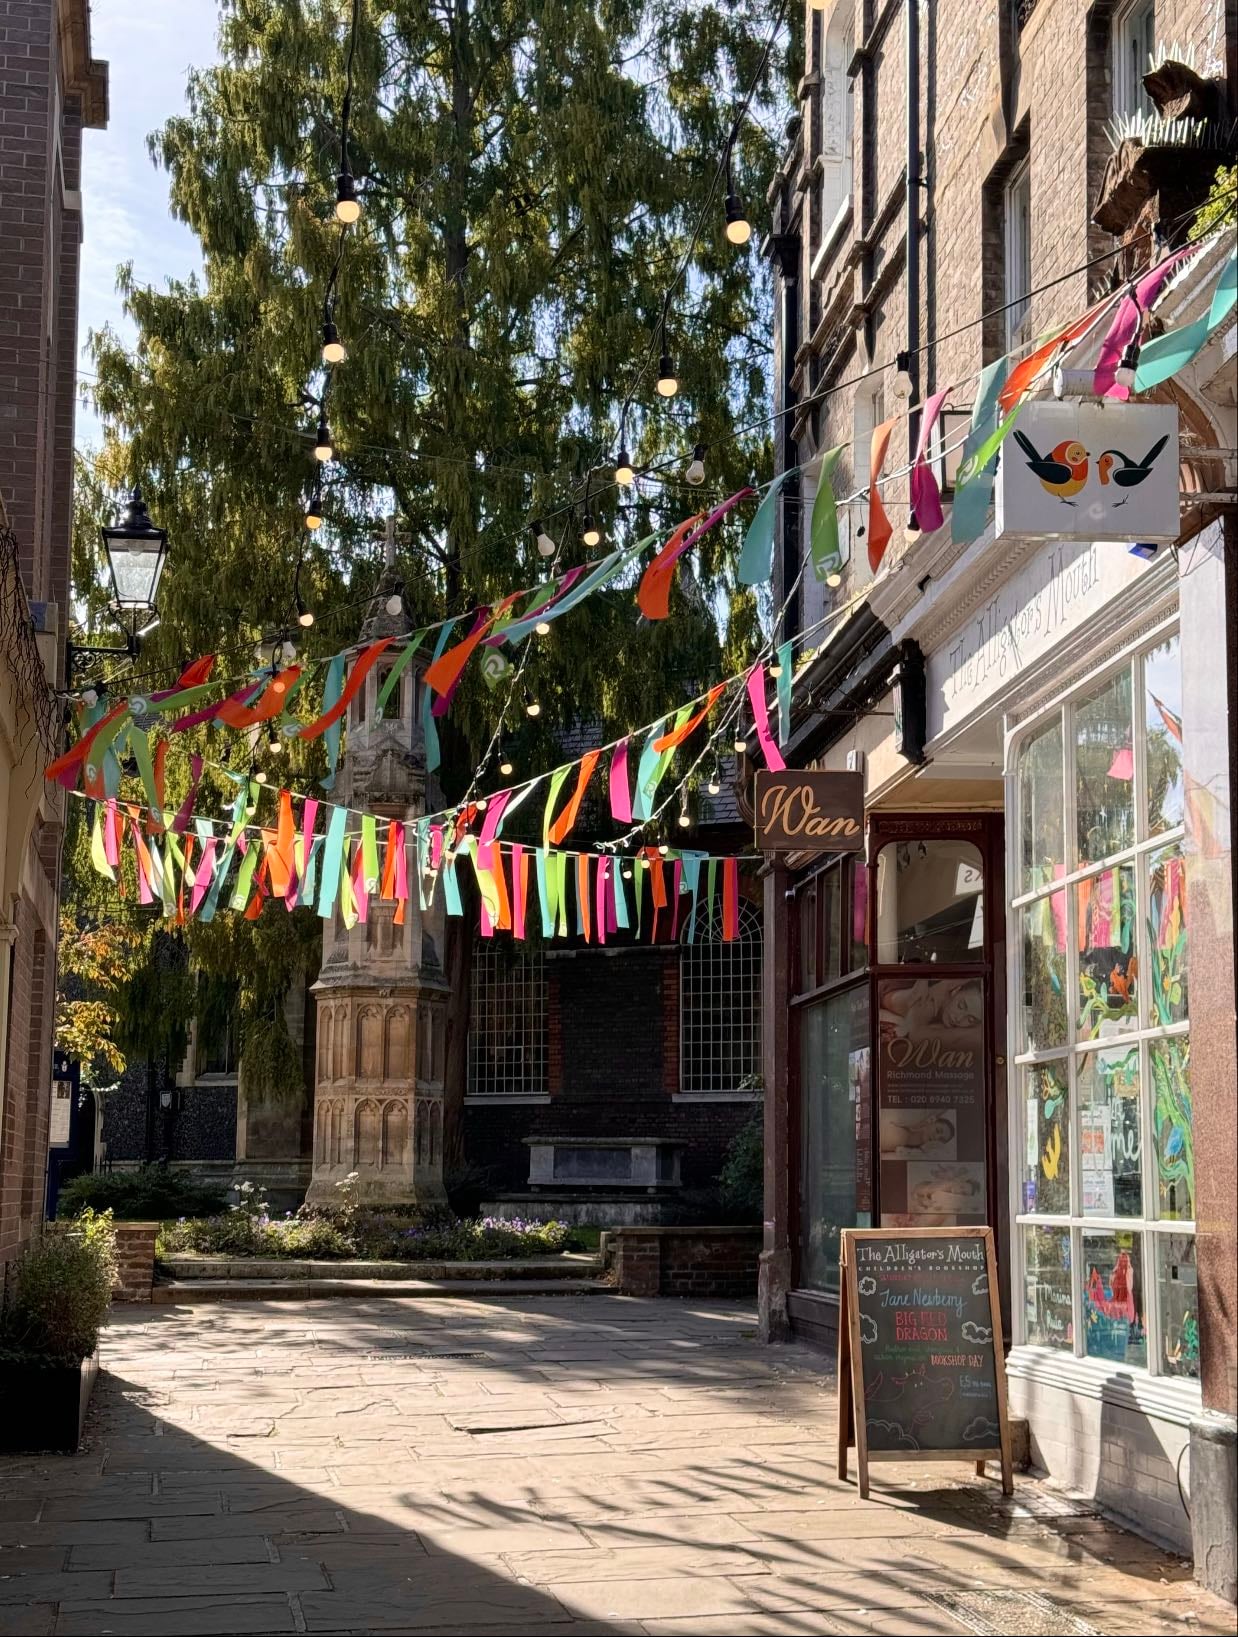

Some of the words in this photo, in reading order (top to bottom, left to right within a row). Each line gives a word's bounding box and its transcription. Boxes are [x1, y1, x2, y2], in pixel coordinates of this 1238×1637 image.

[950, 637, 974, 698] The
[1044, 543, 1099, 637] Mouth
[761, 785, 860, 836] Wan
[887, 1037, 974, 1068] Wan
[887, 1070, 932, 1080] Richmond
[935, 1071, 975, 1081] Massage
[857, 1247, 882, 1262] The
[883, 1244, 945, 1265] Alligator's
[946, 1244, 984, 1262] Mouth
[880, 1288, 911, 1307] Jane
[895, 1311, 917, 1326] BIG
[895, 1327, 948, 1341] DRAGON
[968, 1354, 984, 1368] DAY
